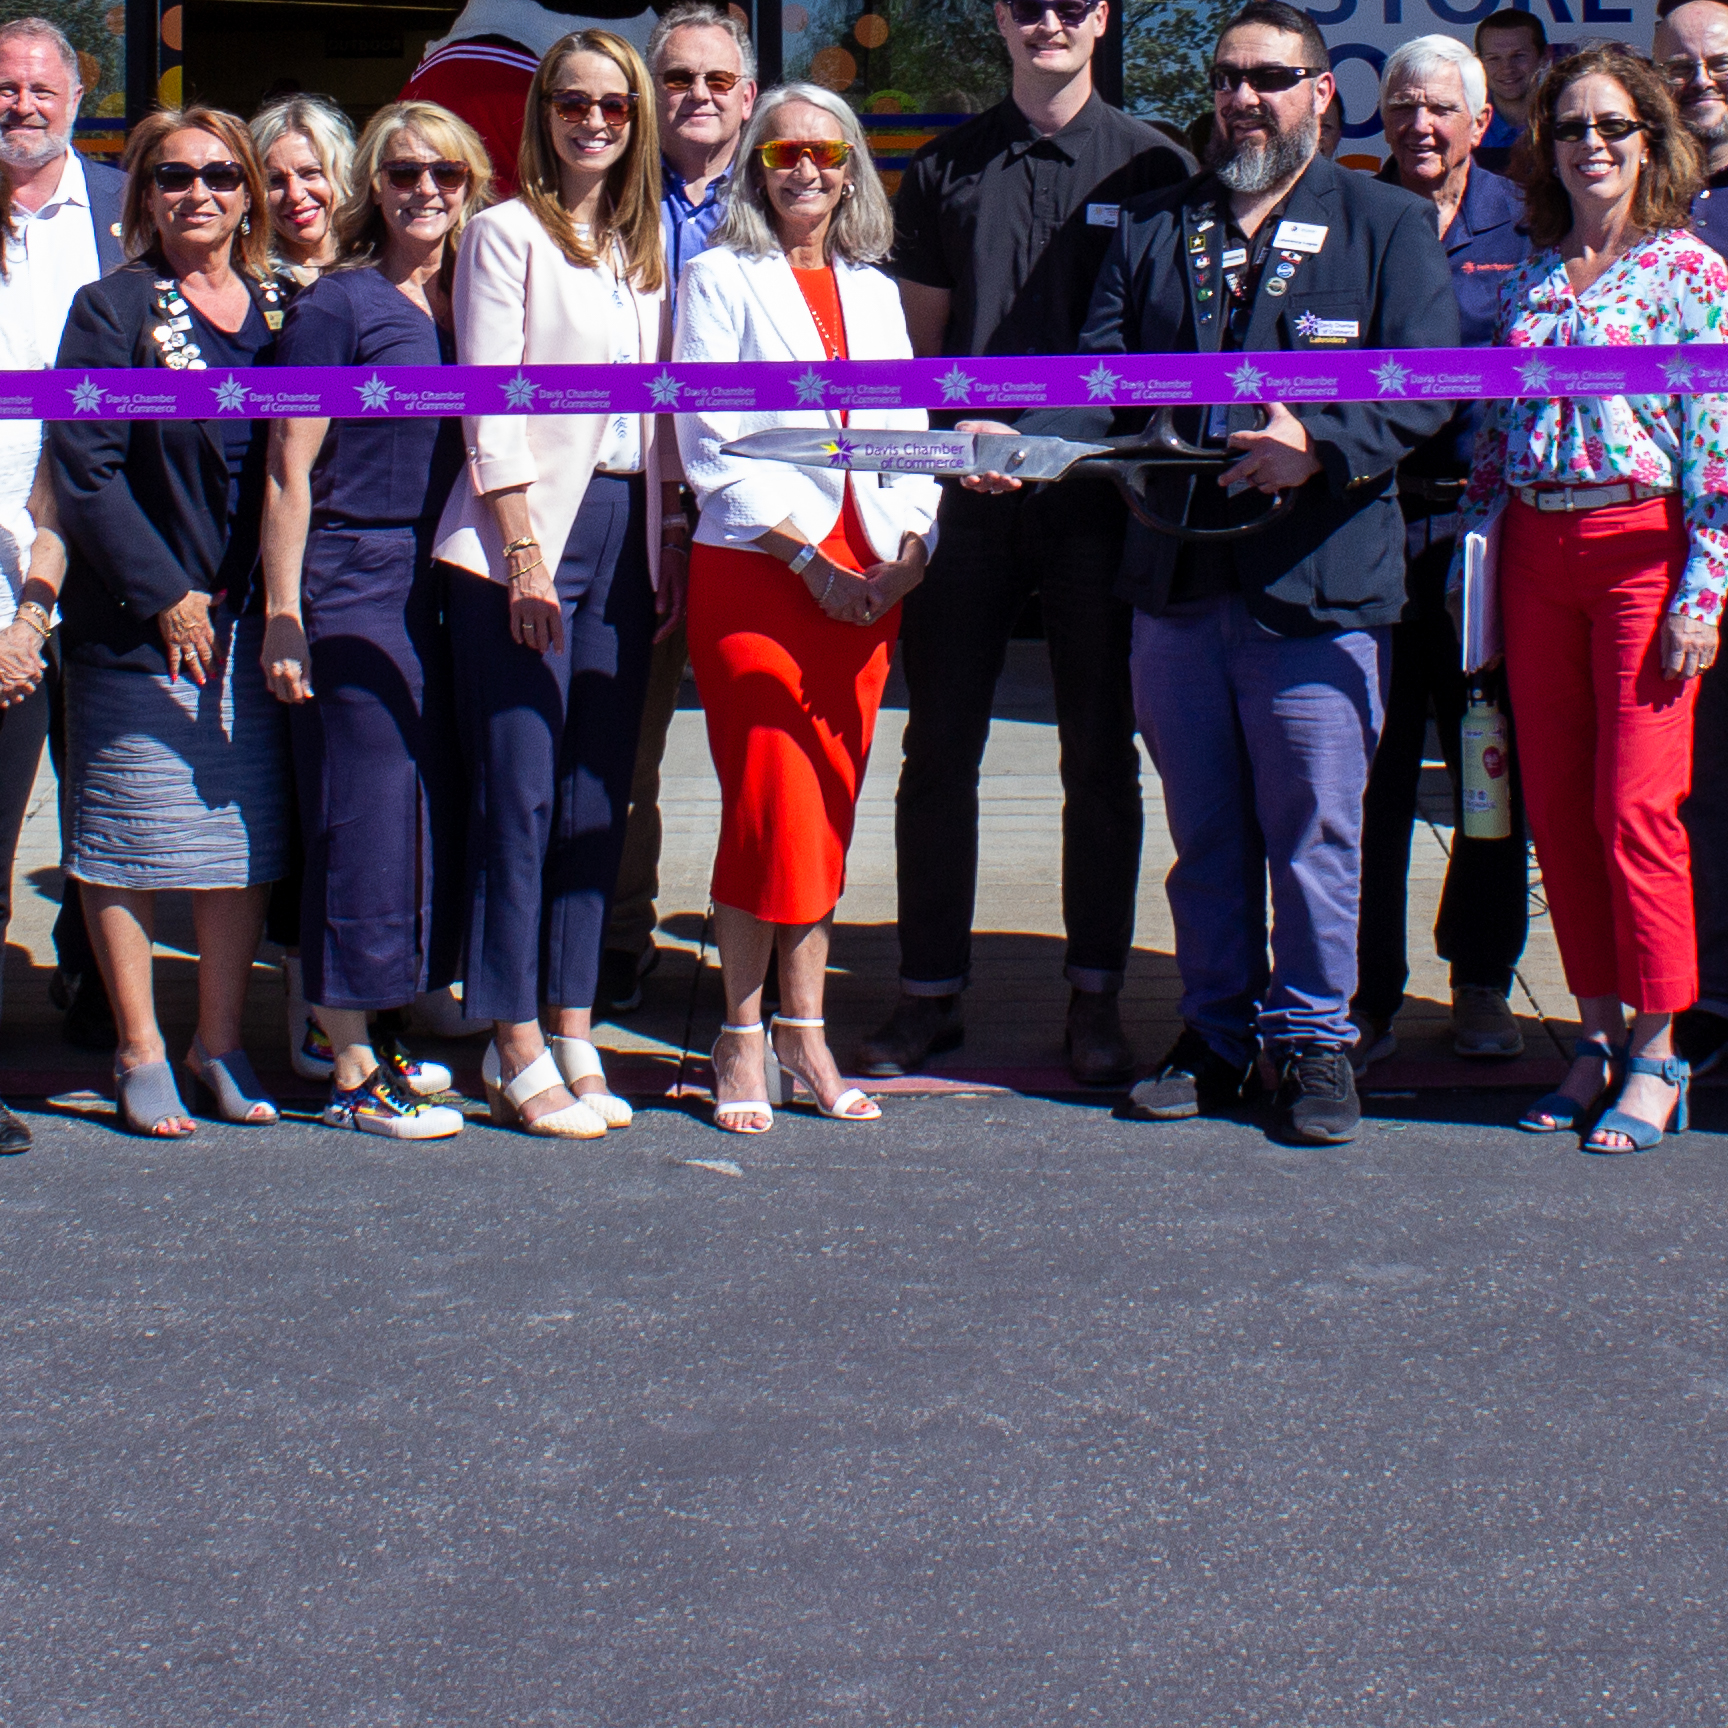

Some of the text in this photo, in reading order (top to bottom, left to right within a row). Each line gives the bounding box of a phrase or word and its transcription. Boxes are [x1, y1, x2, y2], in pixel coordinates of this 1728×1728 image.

[865, 442, 965, 456] Davis Chamber
[881, 457, 964, 469] of Commerce
